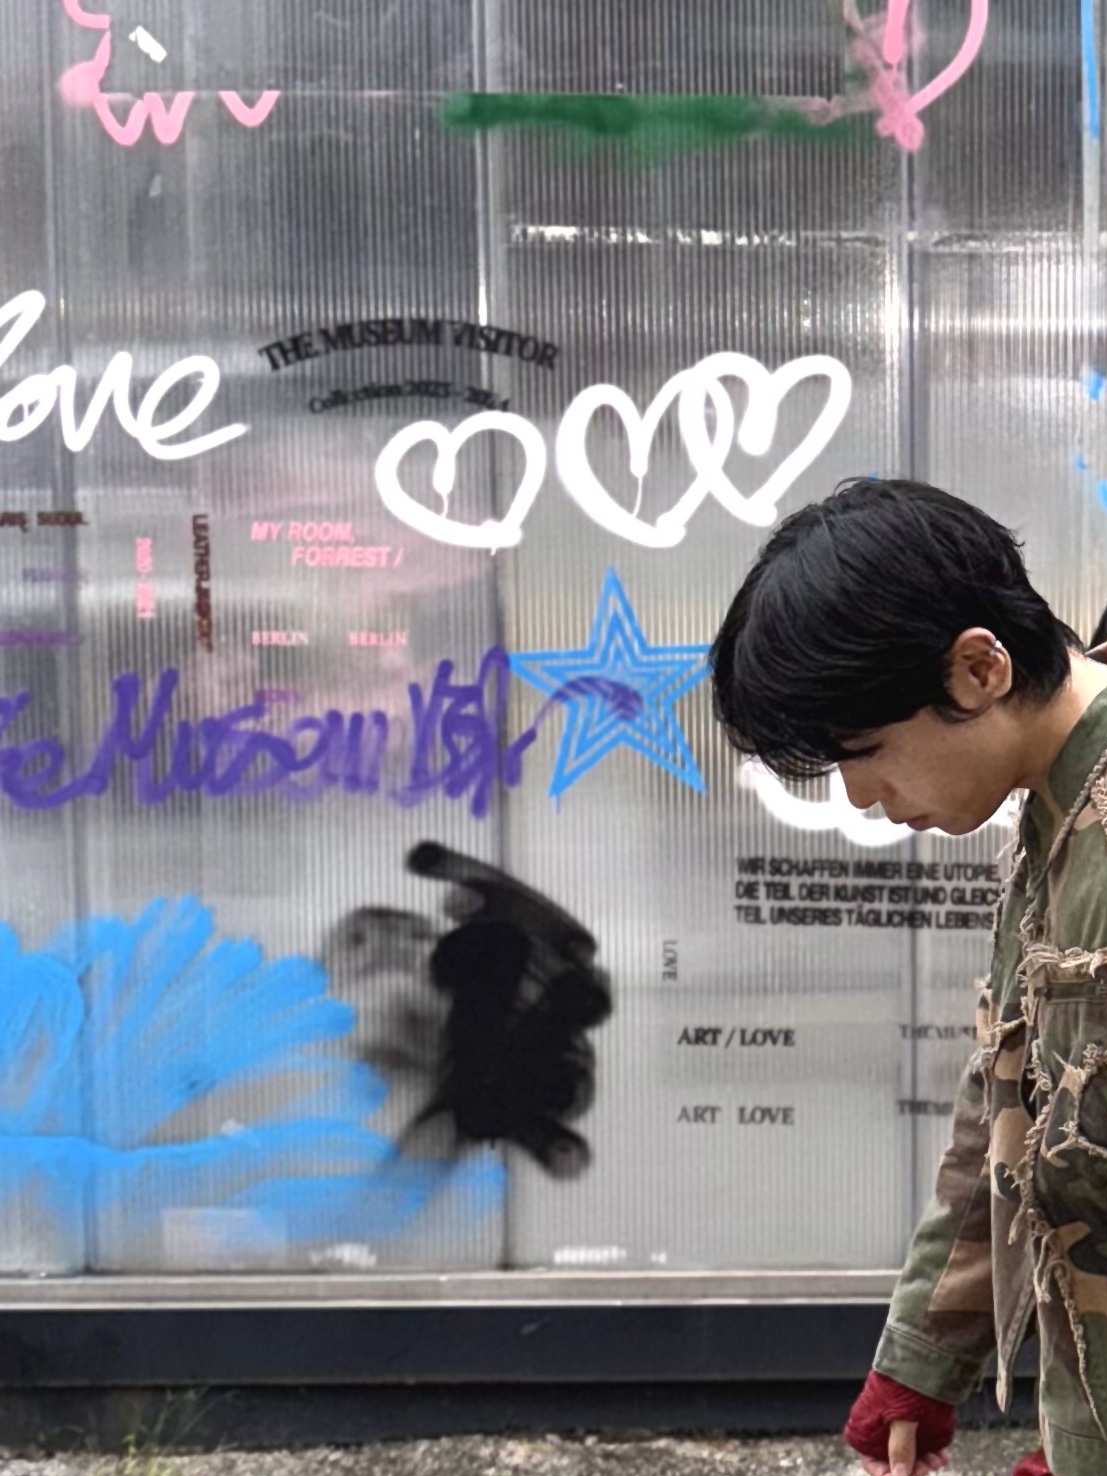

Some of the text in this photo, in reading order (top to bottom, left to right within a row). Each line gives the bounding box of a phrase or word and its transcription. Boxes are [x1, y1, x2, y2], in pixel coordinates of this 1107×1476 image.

[258, 317, 560, 372] THE MUSEUM VISITOR
[308, 382, 401, 414] Collection
[251, 521, 355, 544] MY ROOM,
[192, 513, 211, 582] LEATHER
[290, 546, 391, 568] FORREST
[251, 630, 310, 647] BERLIN
[348, 631, 407, 647] BERLIN
[736, 857, 767, 877] WIR
[768, 858, 850, 880] SCHAFFEN
[852, 860, 902, 881] IMMER
[905, 862, 941, 882] EINE
[734, 880, 1002, 907] DIE TEIL DER KUNST IST UND GLEIC
[734, 905, 767, 925] TEIL
[768, 906, 844, 927] UNSERES
[843, 902, 933, 930] TÄGLICHEN
[661, 939, 679, 982] LOVE
[677, 1026, 723, 1047] ART
[739, 1027, 797, 1048] LOVE
[677, 1104, 796, 1126] ART LOVE
